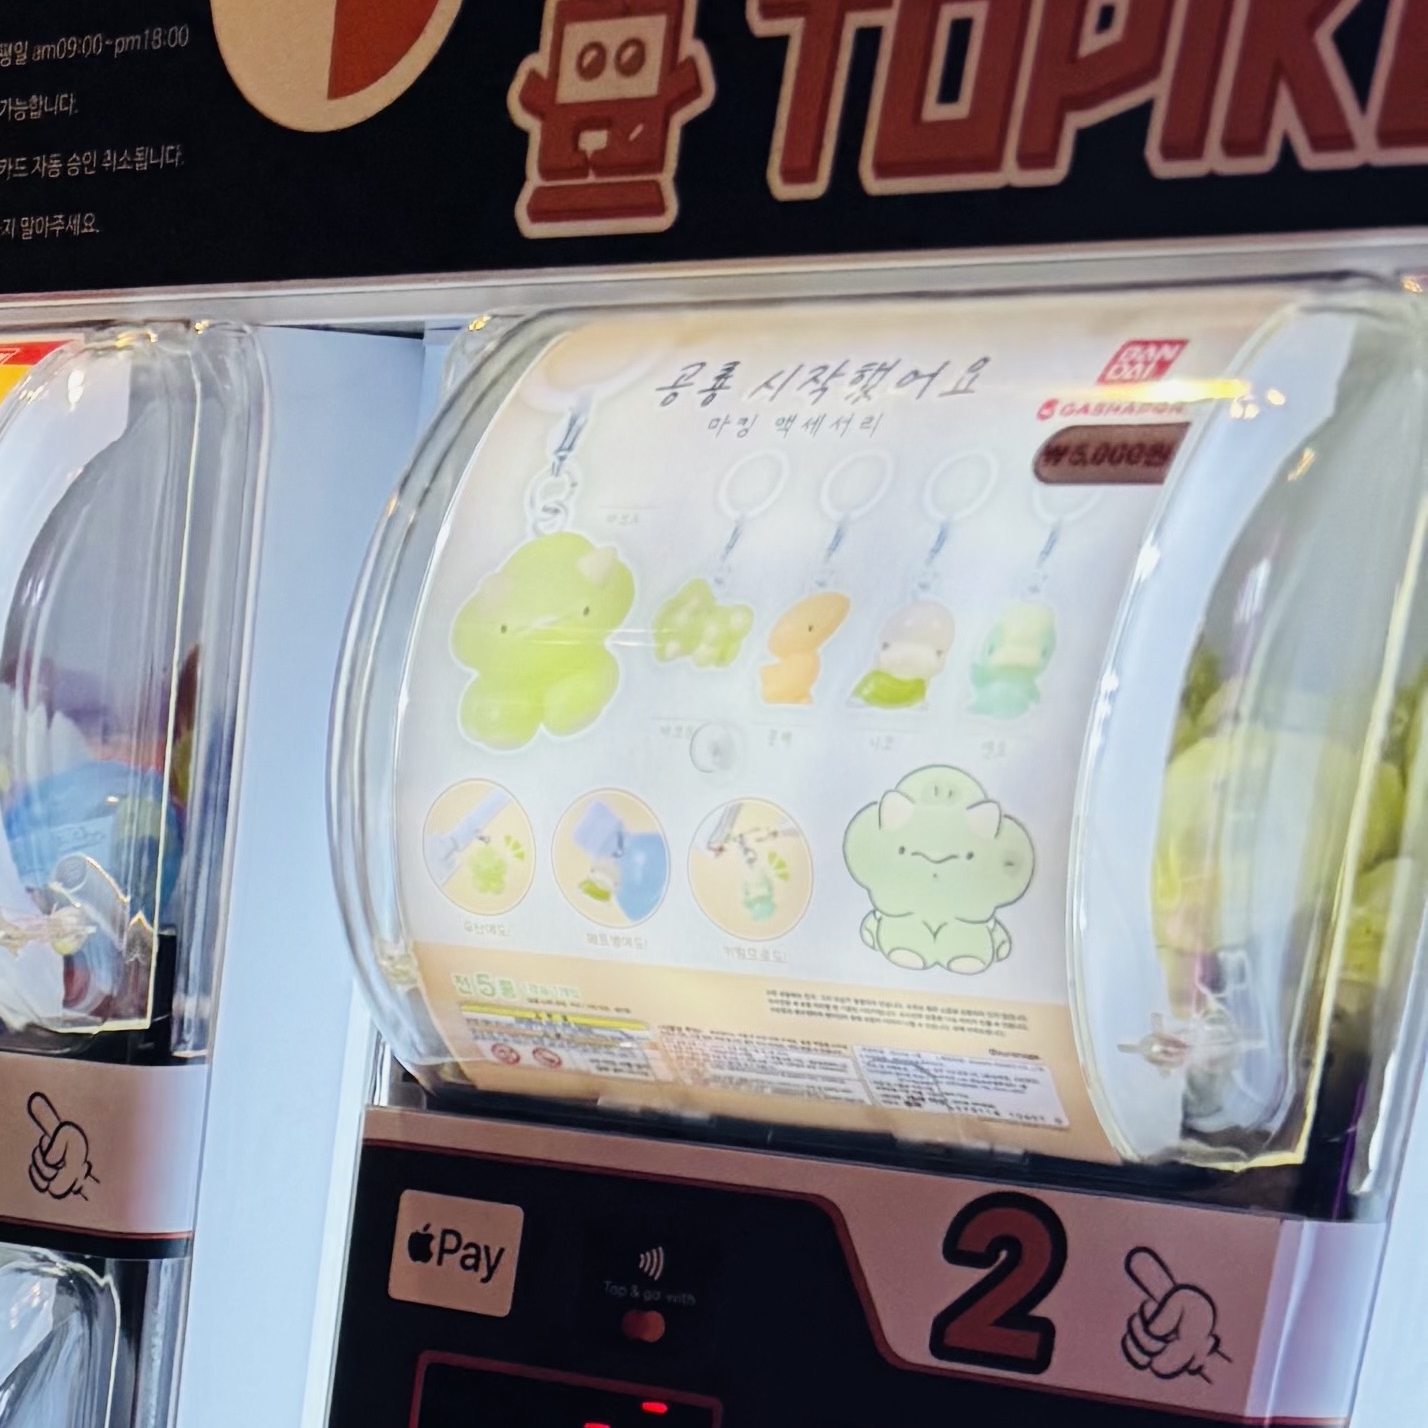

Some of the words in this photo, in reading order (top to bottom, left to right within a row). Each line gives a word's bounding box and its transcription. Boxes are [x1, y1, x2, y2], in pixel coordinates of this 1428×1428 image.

[0, 40, 28, 66] 평일
[32, 153, 62, 178] 자동
[67, 150, 97, 176] 승인
[20, 212, 99, 240] 말아주세요.
[655, 359, 742, 408] 공룡
[749, 355, 992, 407] 시작했어요
[437, 1225, 507, 1284] Pay
[929, 1190, 1069, 1375] 2
